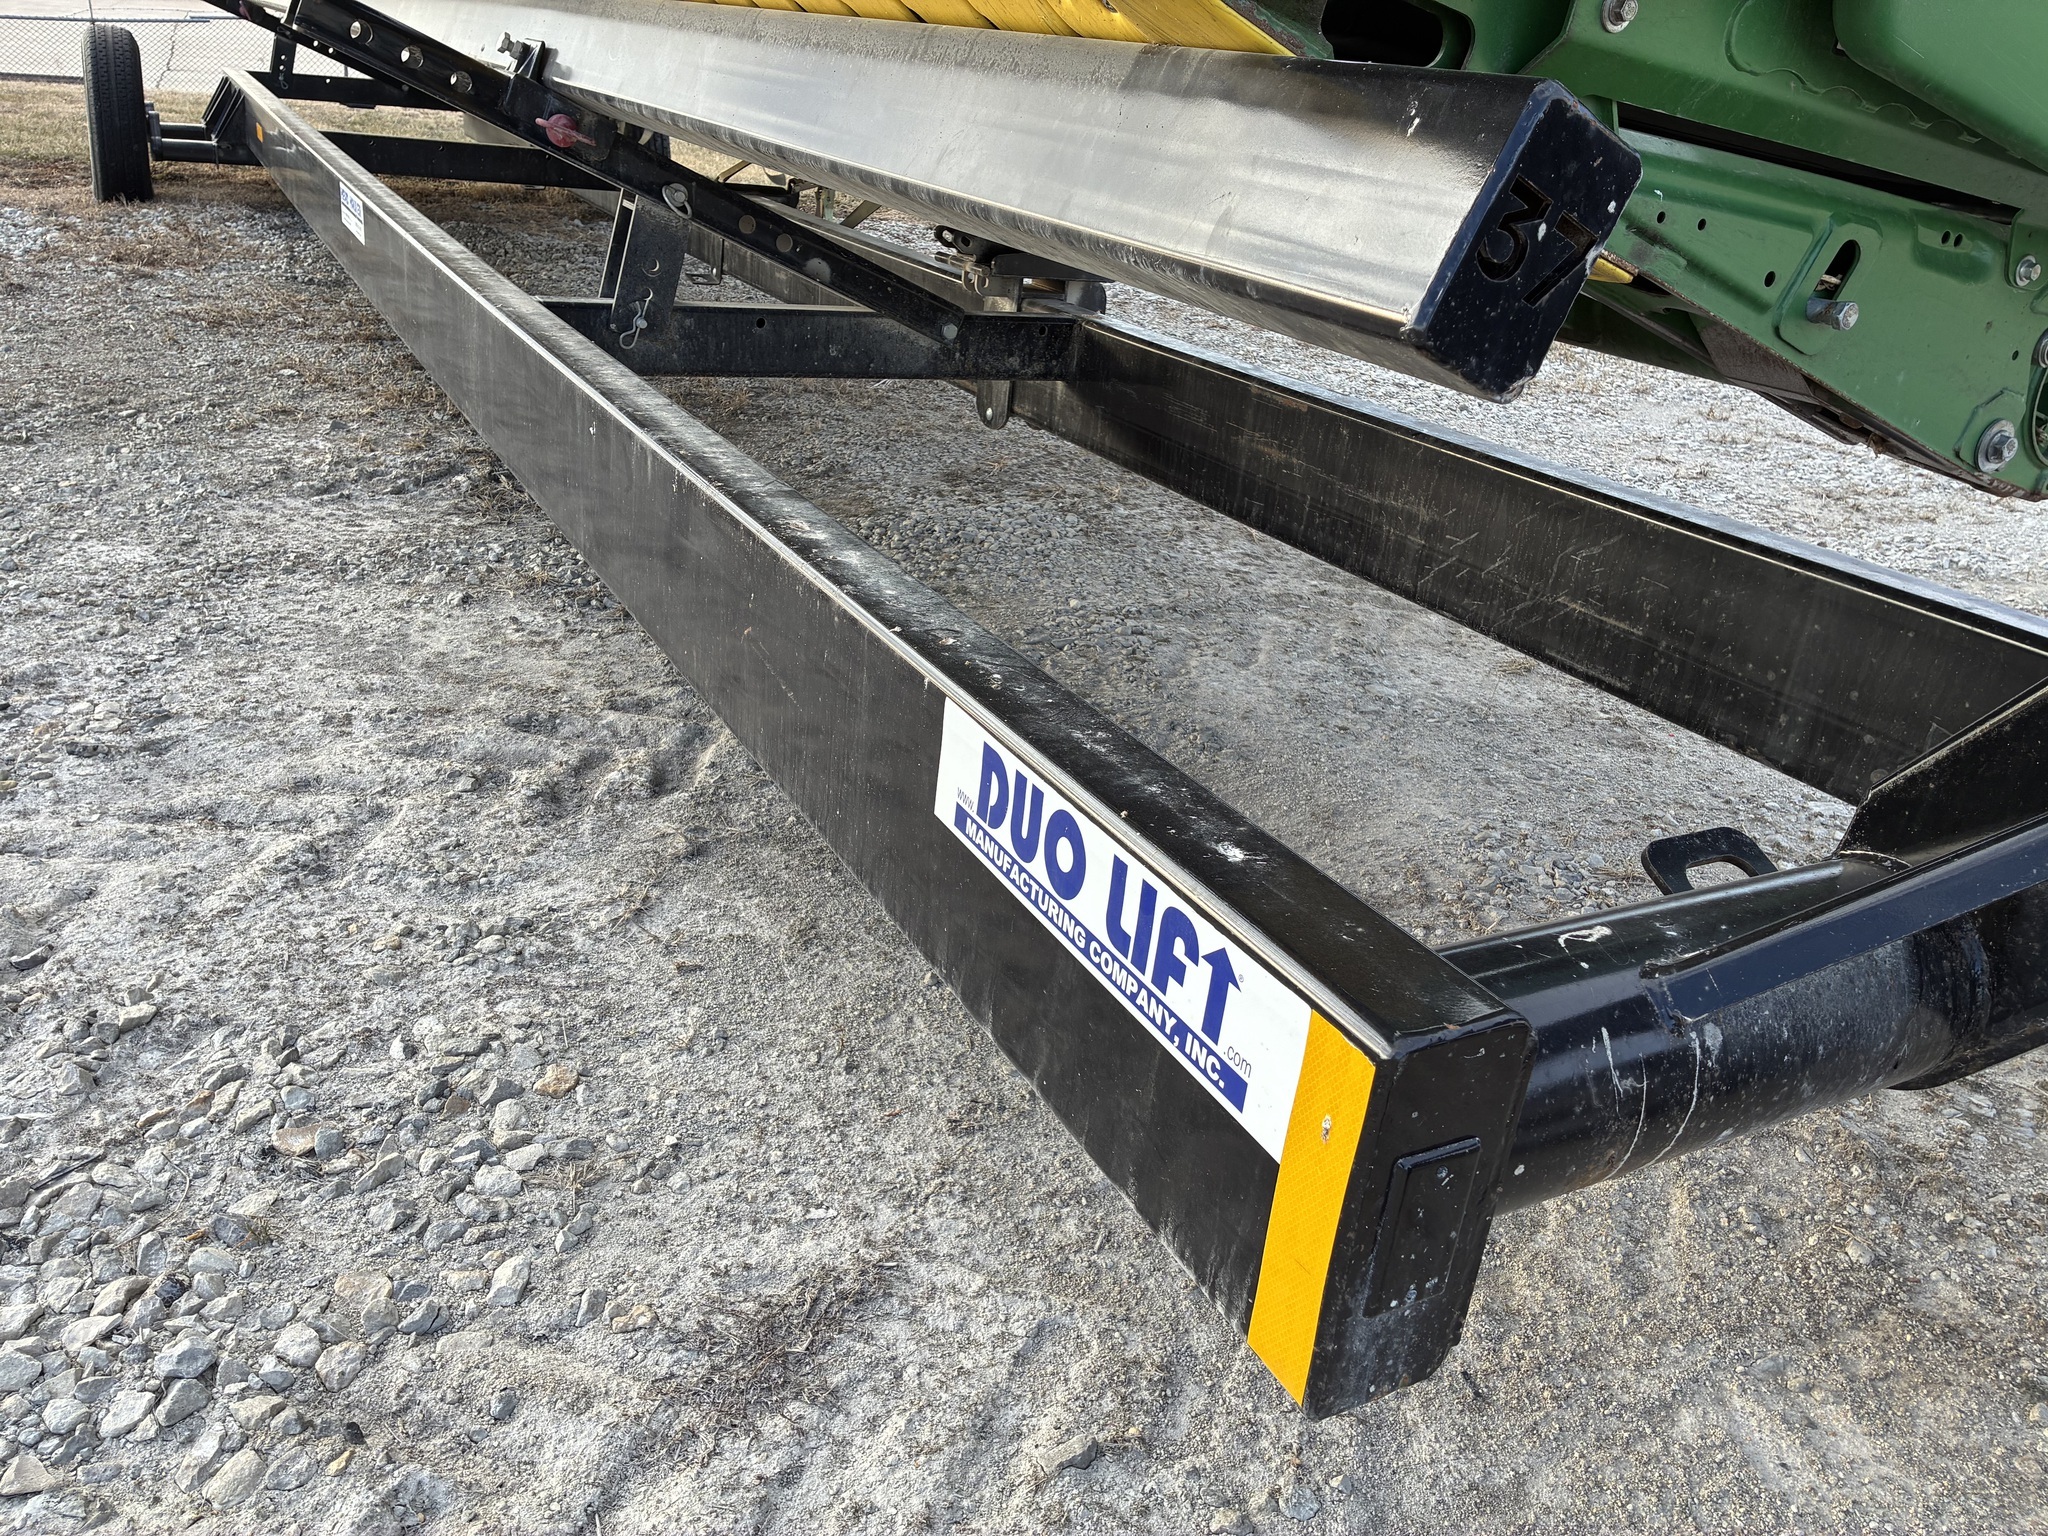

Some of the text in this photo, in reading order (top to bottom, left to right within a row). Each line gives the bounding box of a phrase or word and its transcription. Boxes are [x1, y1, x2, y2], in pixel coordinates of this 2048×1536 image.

[1475, 173, 1600, 309] 37
[965, 816, 1226, 1089] MANUFACTURING COMPANY, INC.
[976, 740, 1087, 901] DUO
[1106, 854, 1242, 1047] LIFT
